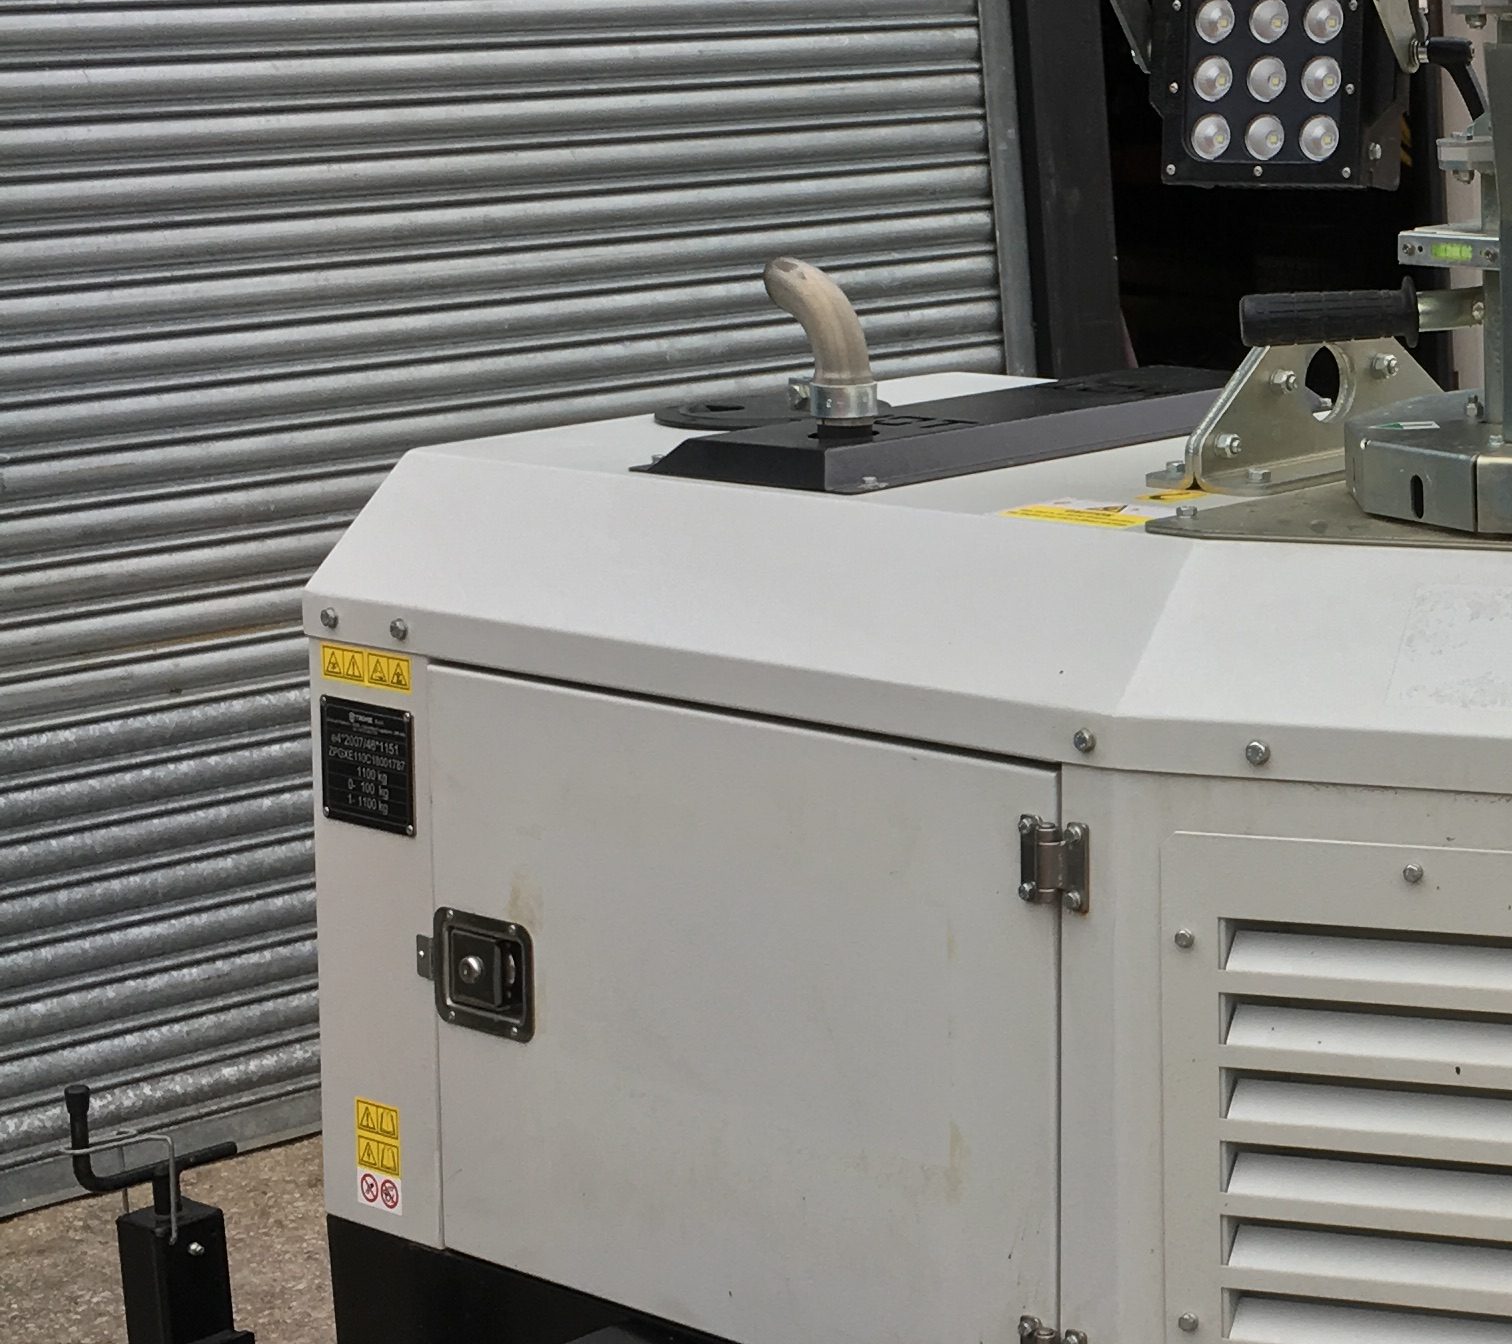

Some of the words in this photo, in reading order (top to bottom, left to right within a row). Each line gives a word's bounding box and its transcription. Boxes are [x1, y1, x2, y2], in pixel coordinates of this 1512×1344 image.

[357, 766, 376, 781] 1100
[378, 771, 388, 786] kg
[361, 782, 375, 794] 100
[379, 785, 389, 800] kg
[358, 796, 377, 810] 1100
[379, 800, 389, 815] kg
